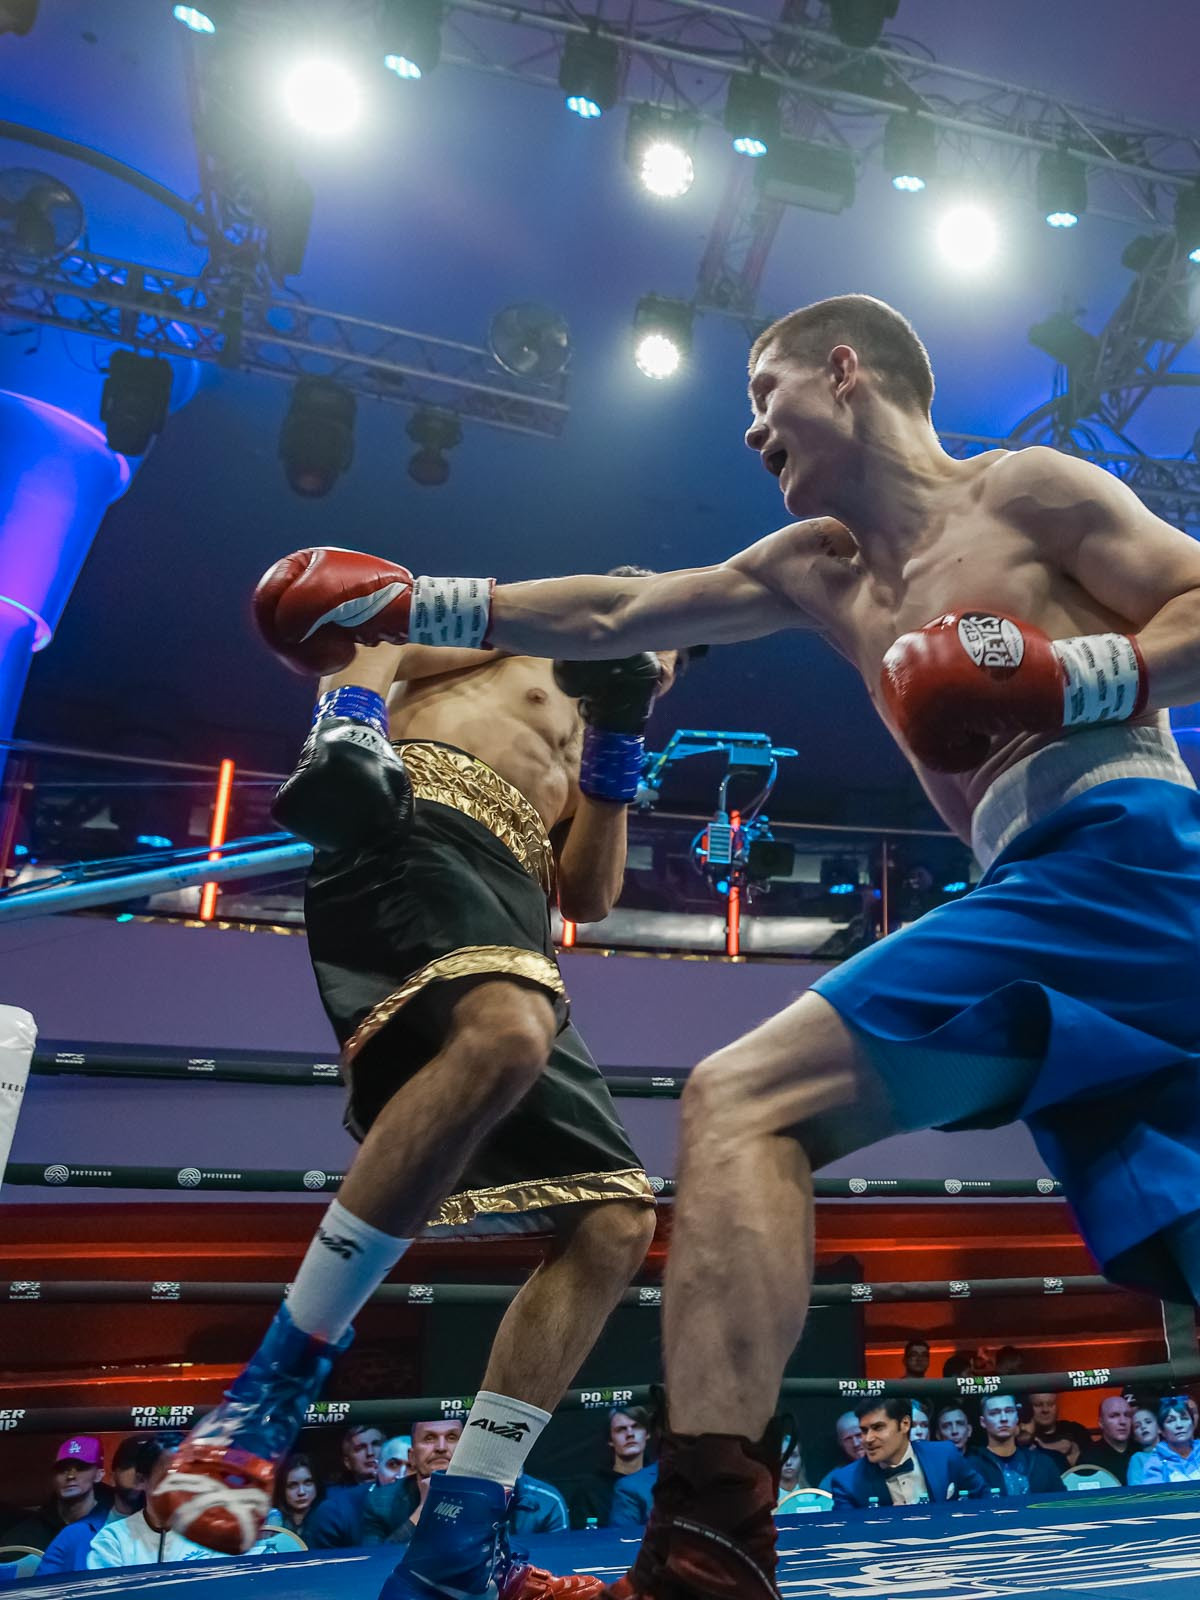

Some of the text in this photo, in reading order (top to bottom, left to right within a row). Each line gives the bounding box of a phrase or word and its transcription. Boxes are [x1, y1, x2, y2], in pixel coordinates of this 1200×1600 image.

[1072, 1376, 1109, 1386] HEMP
[960, 1384, 998, 1394] HEMP
[305, 1402, 351, 1414] OWER
[135, 1416, 188, 1427] HEMP
[433, 1501, 463, 1519] NIKE
